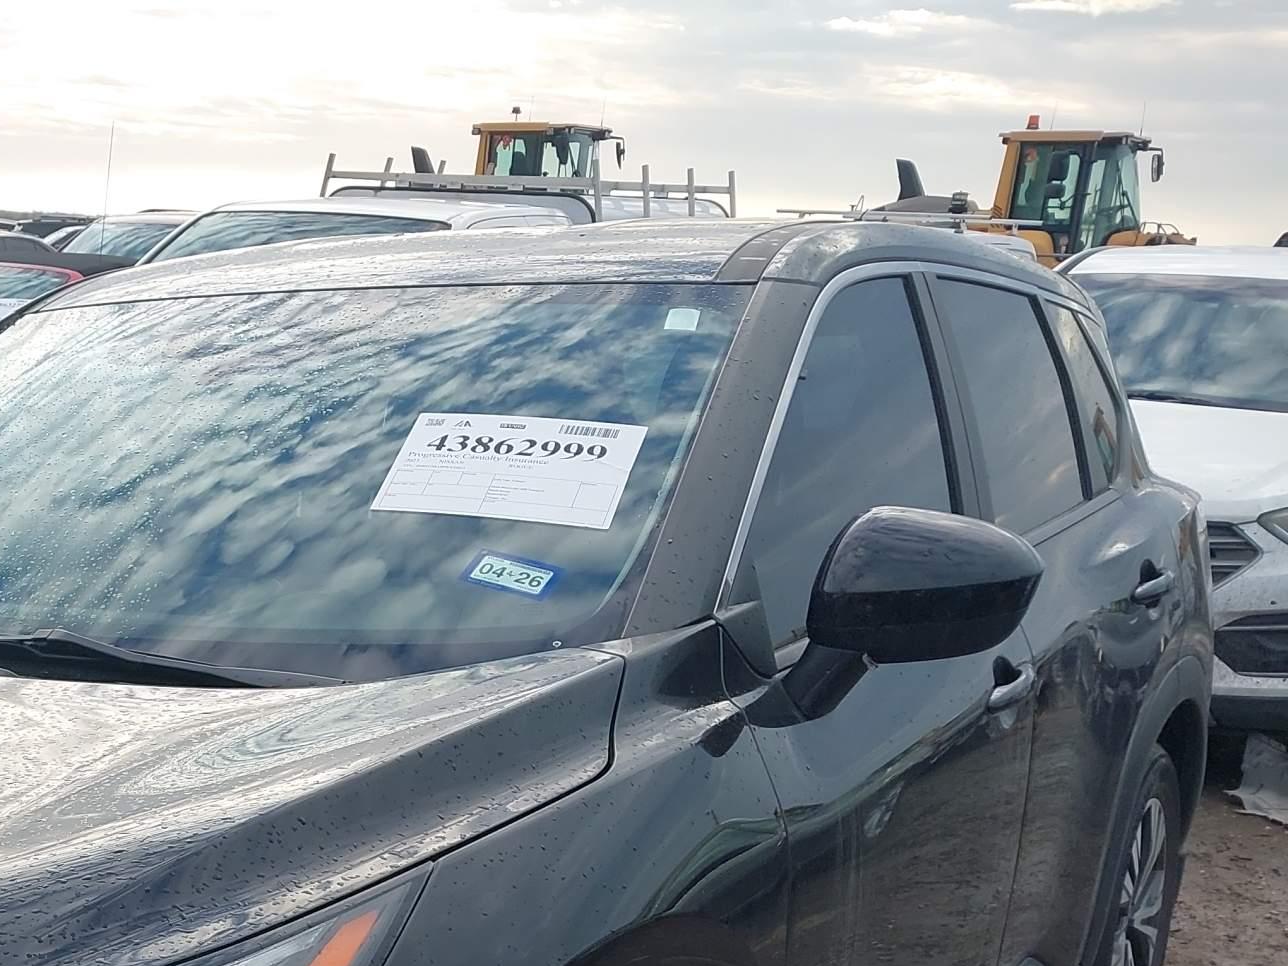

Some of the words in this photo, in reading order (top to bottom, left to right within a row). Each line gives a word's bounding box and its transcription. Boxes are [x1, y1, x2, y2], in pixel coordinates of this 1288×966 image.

[408, 451, 460, 460] Progressive
[427, 434, 607, 462] 43862999
[479, 562, 507, 578] 04
[513, 572, 544, 588] 26
